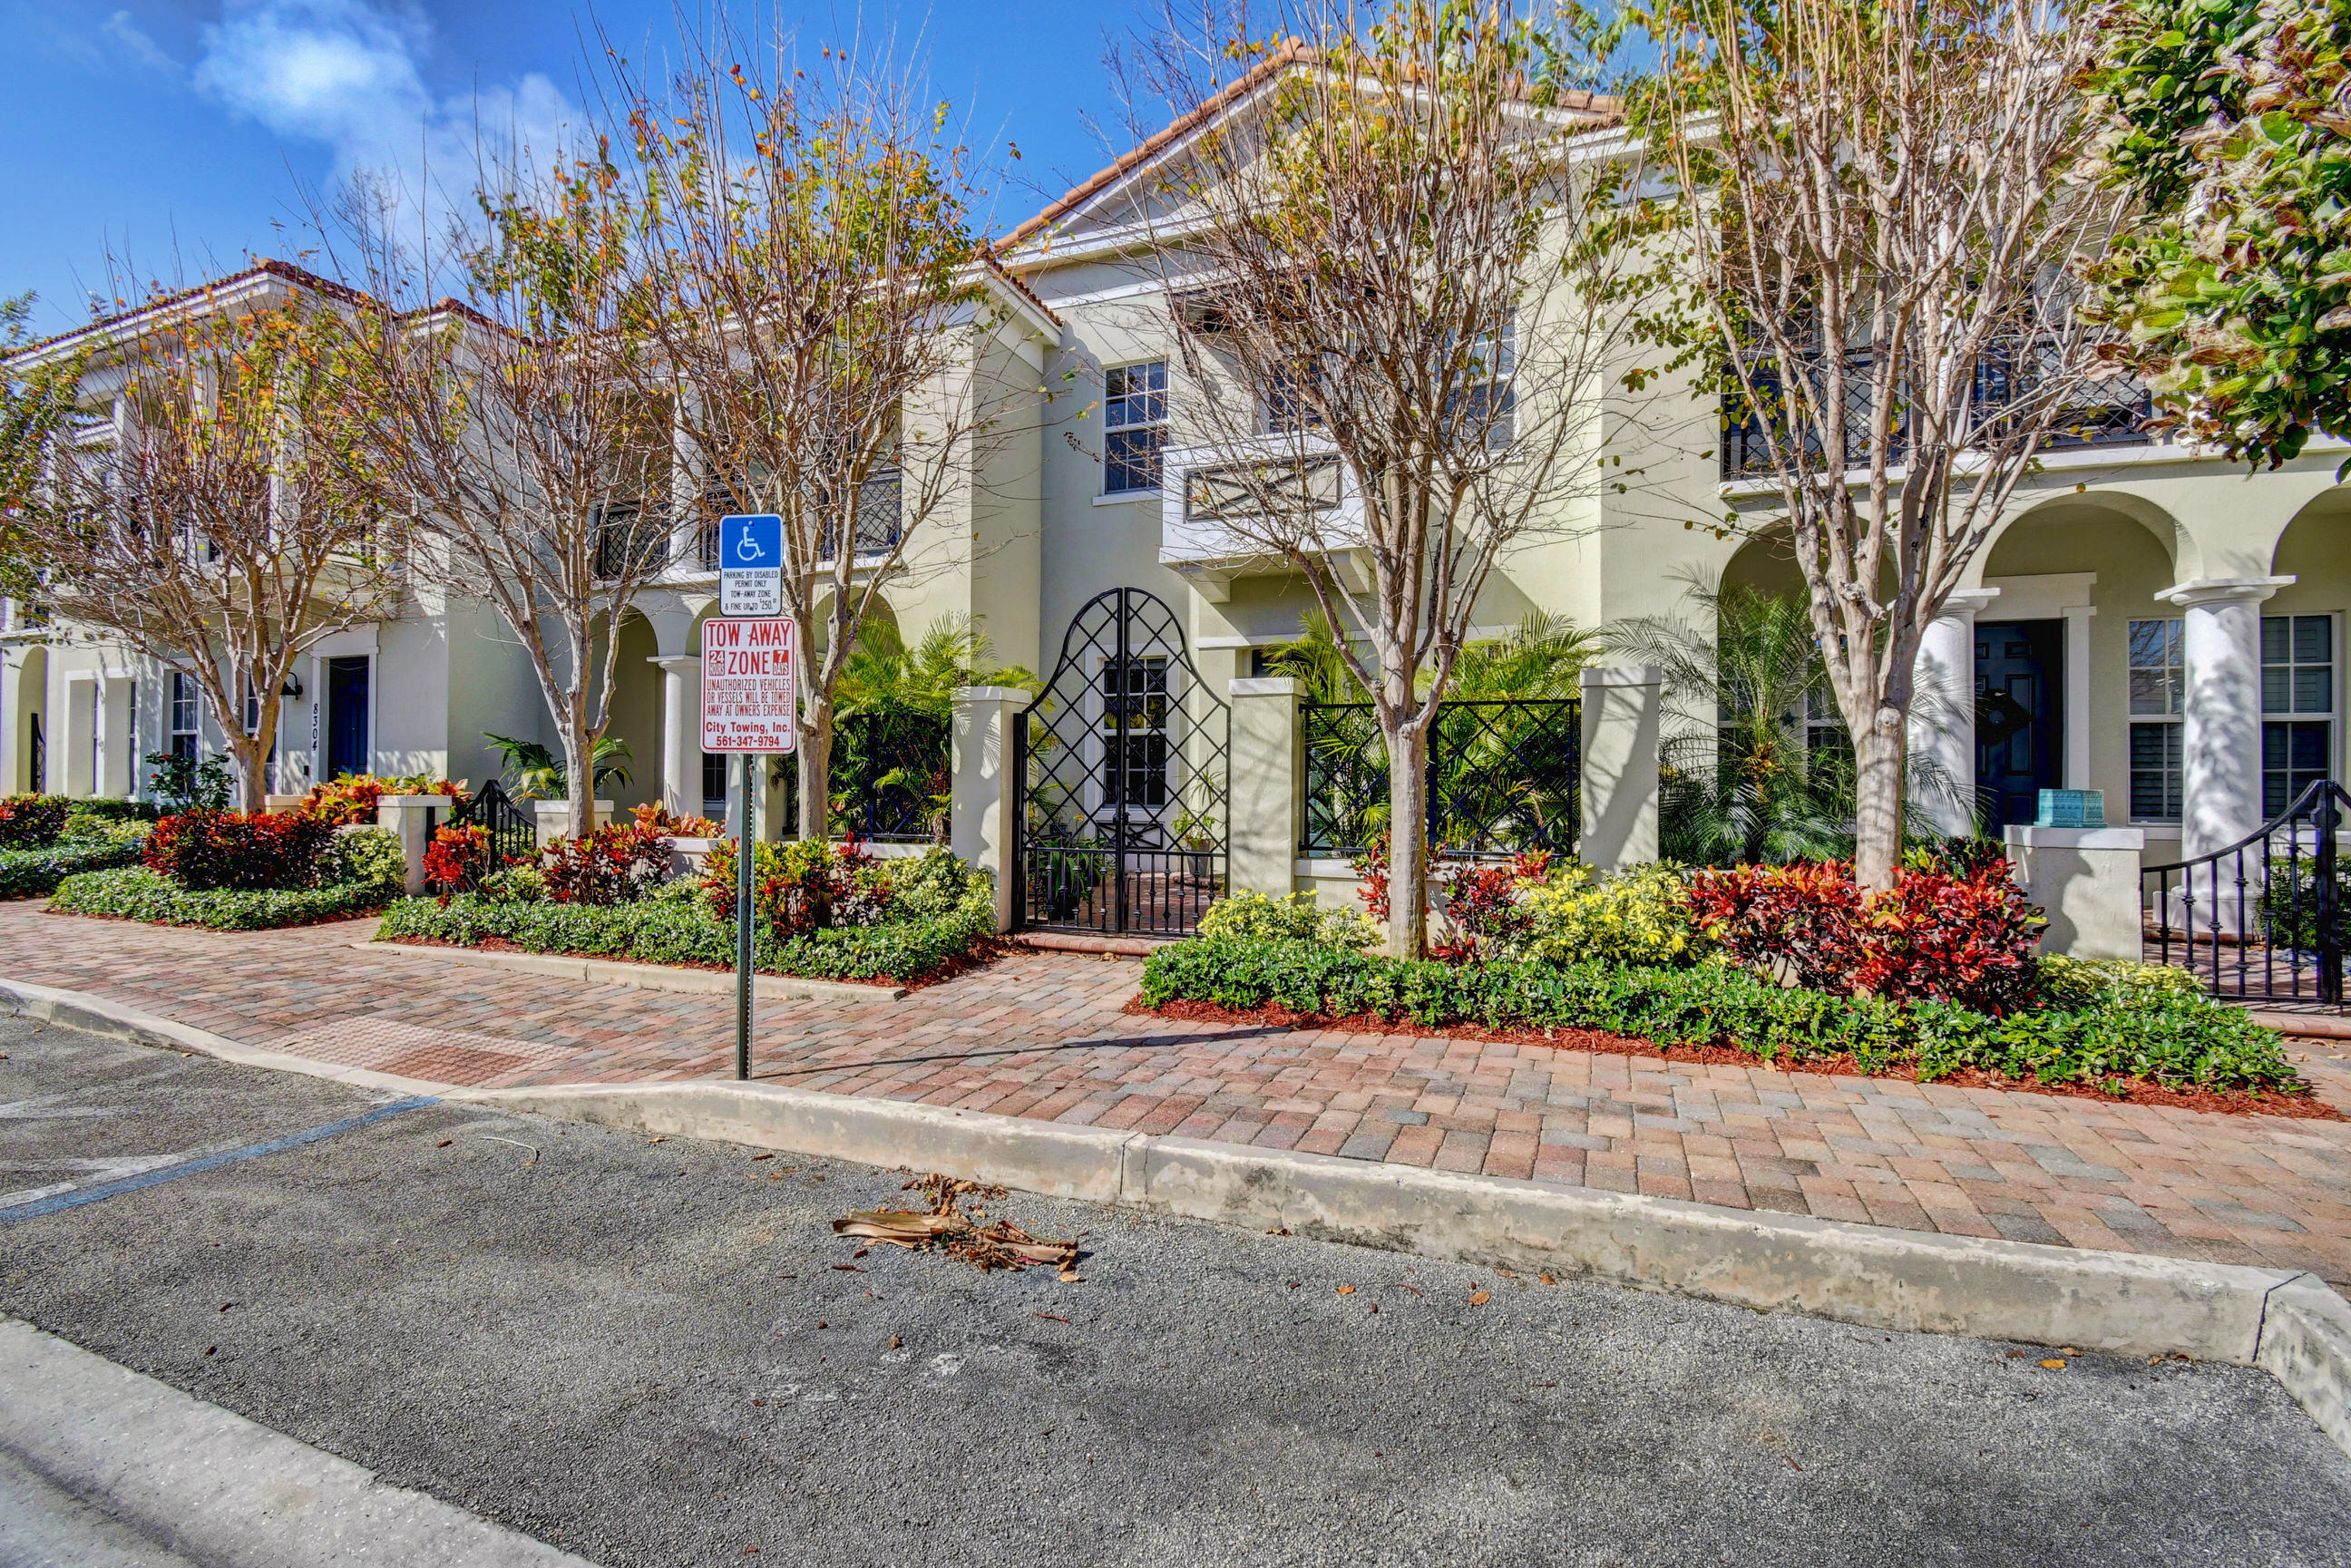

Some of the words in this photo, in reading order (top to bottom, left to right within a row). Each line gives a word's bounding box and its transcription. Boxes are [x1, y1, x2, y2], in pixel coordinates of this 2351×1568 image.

[754, 570, 779, 579] DISABLED
[755, 579, 766, 588] ONLY
[757, 589, 771, 598] ZONE
[752, 602, 758, 610] TO
[708, 623, 741, 647] TOW
[748, 622, 791, 647] AWAY
[709, 650, 725, 664] 24
[728, 650, 770, 675] ZONE
[777, 650, 785, 663] 7
[709, 663, 725, 676] HOURS
[774, 662, 788, 676] DAYS
[707, 678, 756, 691] UNAUTHORIZED
[759, 678, 791, 690] VEHICLES
[707, 692, 715, 704] OR
[717, 692, 743, 704] VESSELS
[746, 692, 758, 704] WILL
[761, 692, 768, 704] BE
[771, 691, 791, 703] TOWED
[707, 705, 723, 716] AWAY
[725, 705, 732, 716] AT
[735, 705, 761, 716] OWNERS
[763, 704, 791, 716] EXPENSE
[706, 722, 727, 735] City
[730, 722, 768, 735] Towing,
[773, 721, 791, 733] Inc.
[716, 735, 780, 746] 561-347-9794
